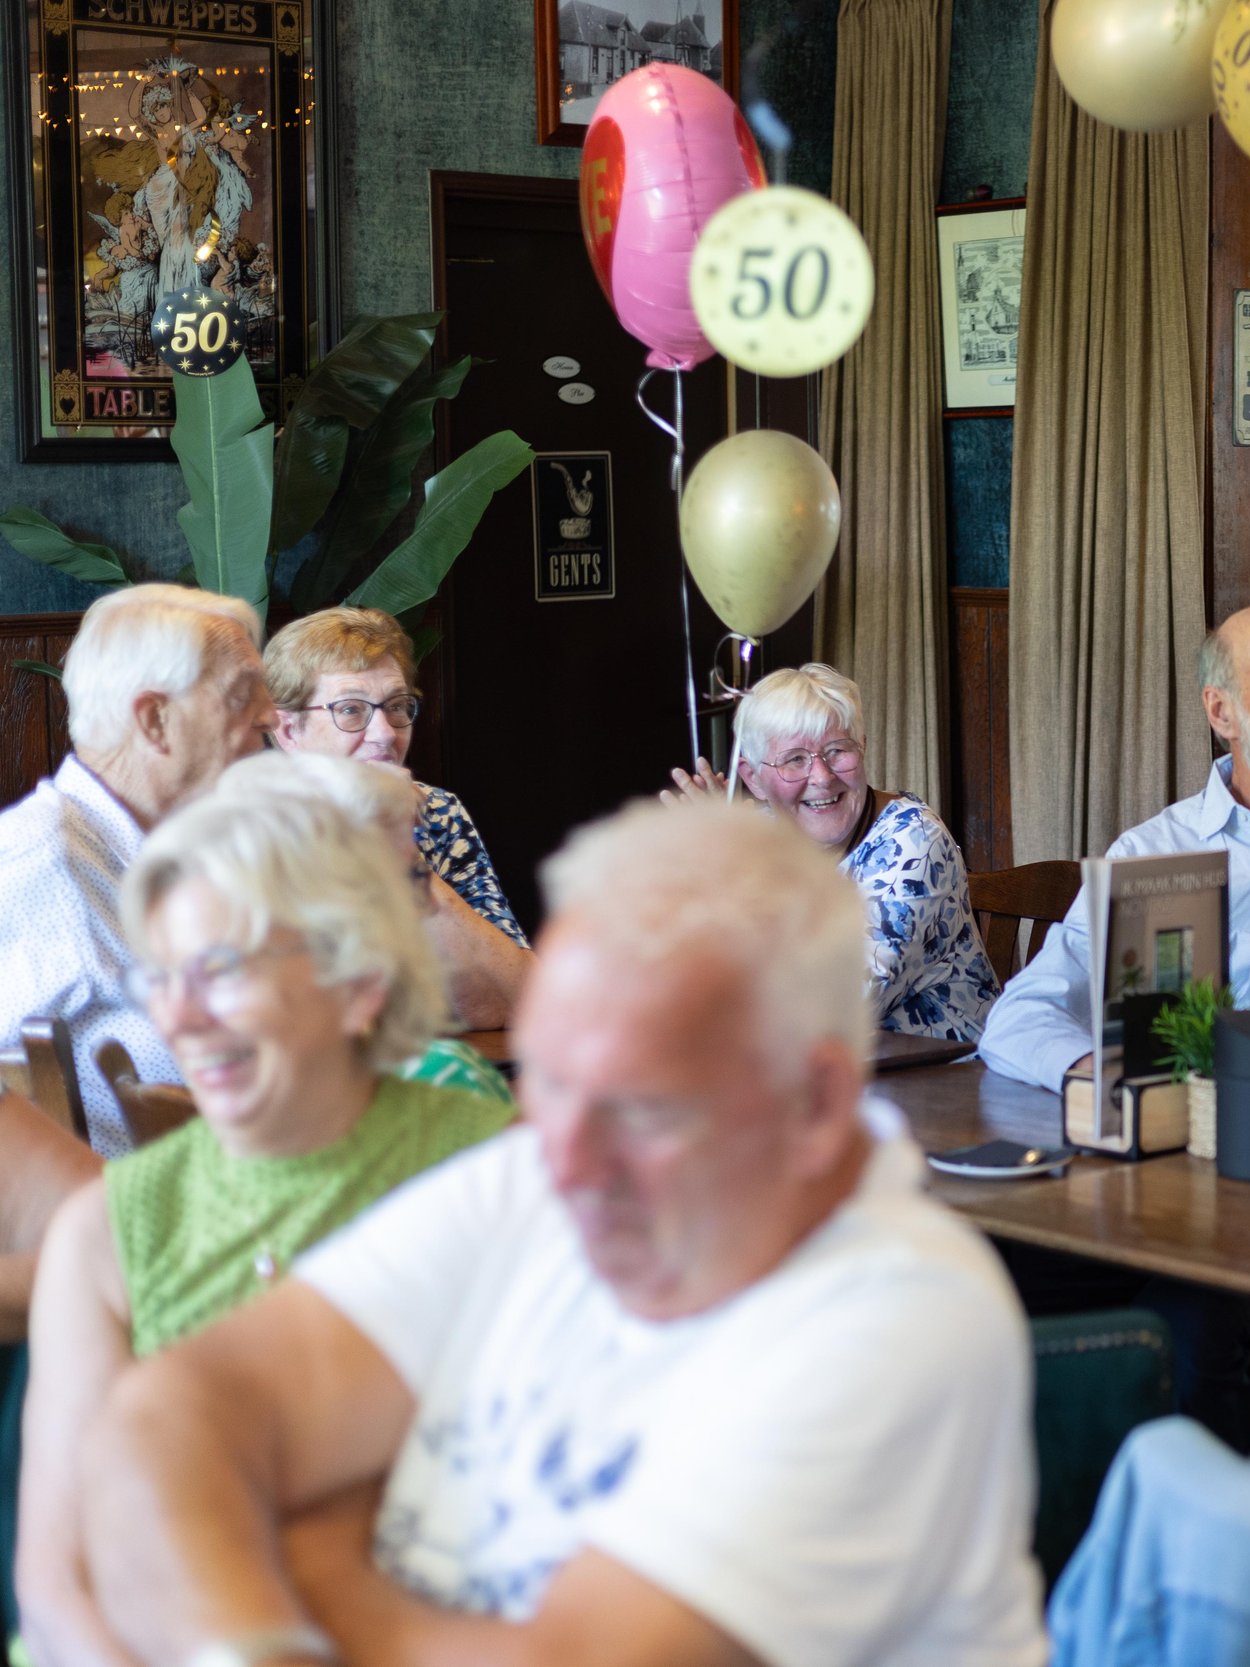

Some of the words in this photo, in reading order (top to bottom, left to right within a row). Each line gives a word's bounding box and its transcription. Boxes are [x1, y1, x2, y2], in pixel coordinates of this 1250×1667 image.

[88, 0, 257, 33] SCHWEPPES
[731, 245, 831, 321] 50
[171, 312, 228, 353] 50
[87, 387, 170, 417] TABLE
[550, 553, 601, 587] GENTS
